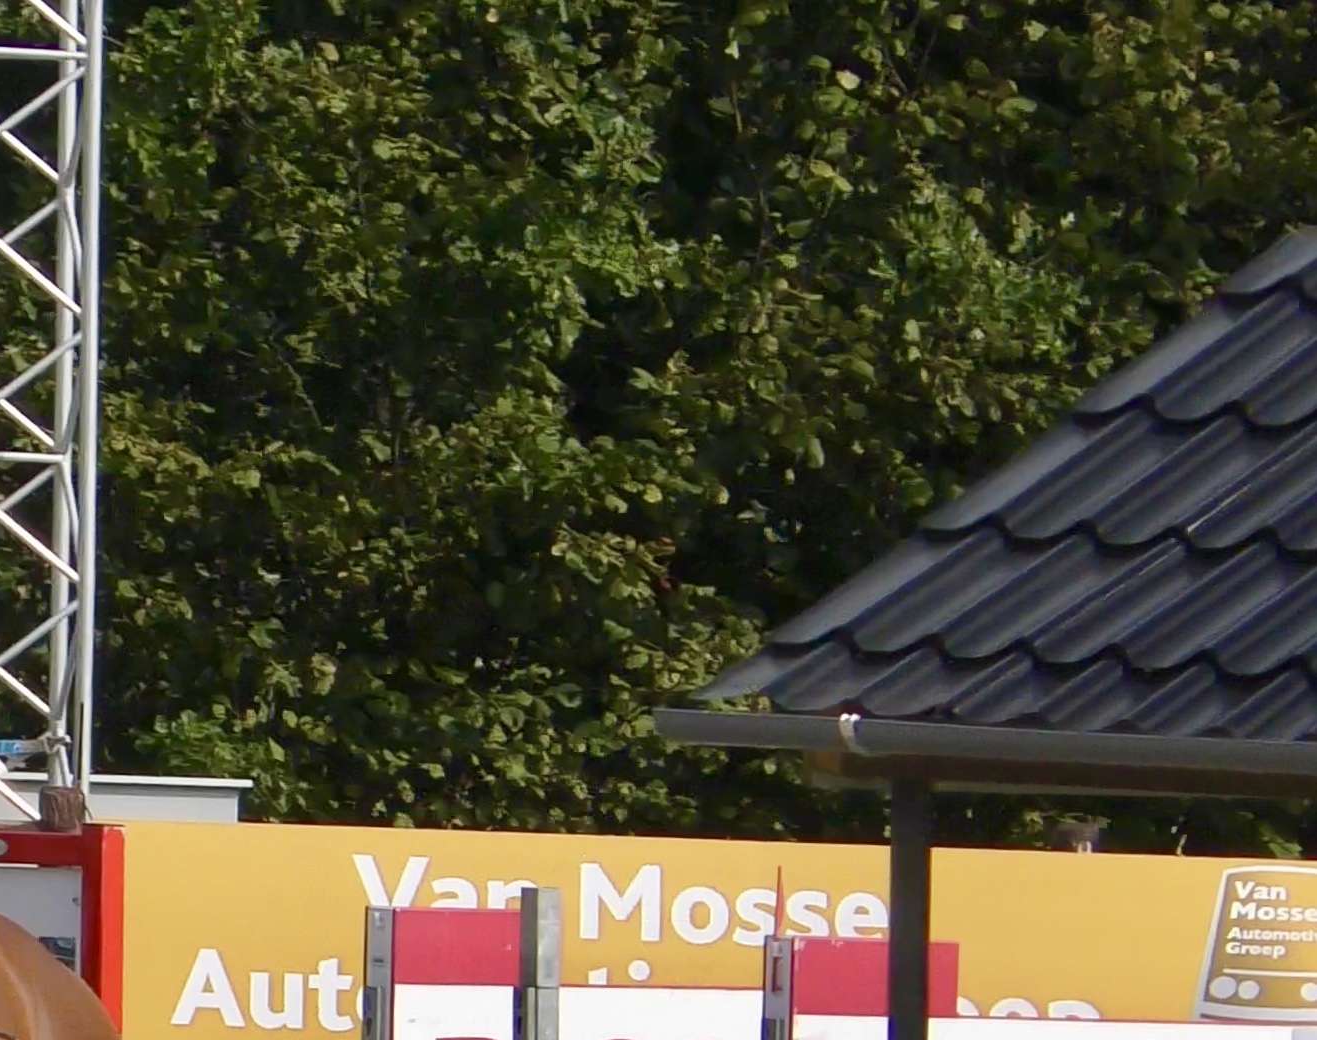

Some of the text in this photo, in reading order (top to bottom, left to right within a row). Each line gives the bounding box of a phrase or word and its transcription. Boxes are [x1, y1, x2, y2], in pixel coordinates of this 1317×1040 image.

[1234, 880, 1287, 900] Van
[1224, 941, 1287, 959] Groep
[171, 948, 363, 1032] Aut
